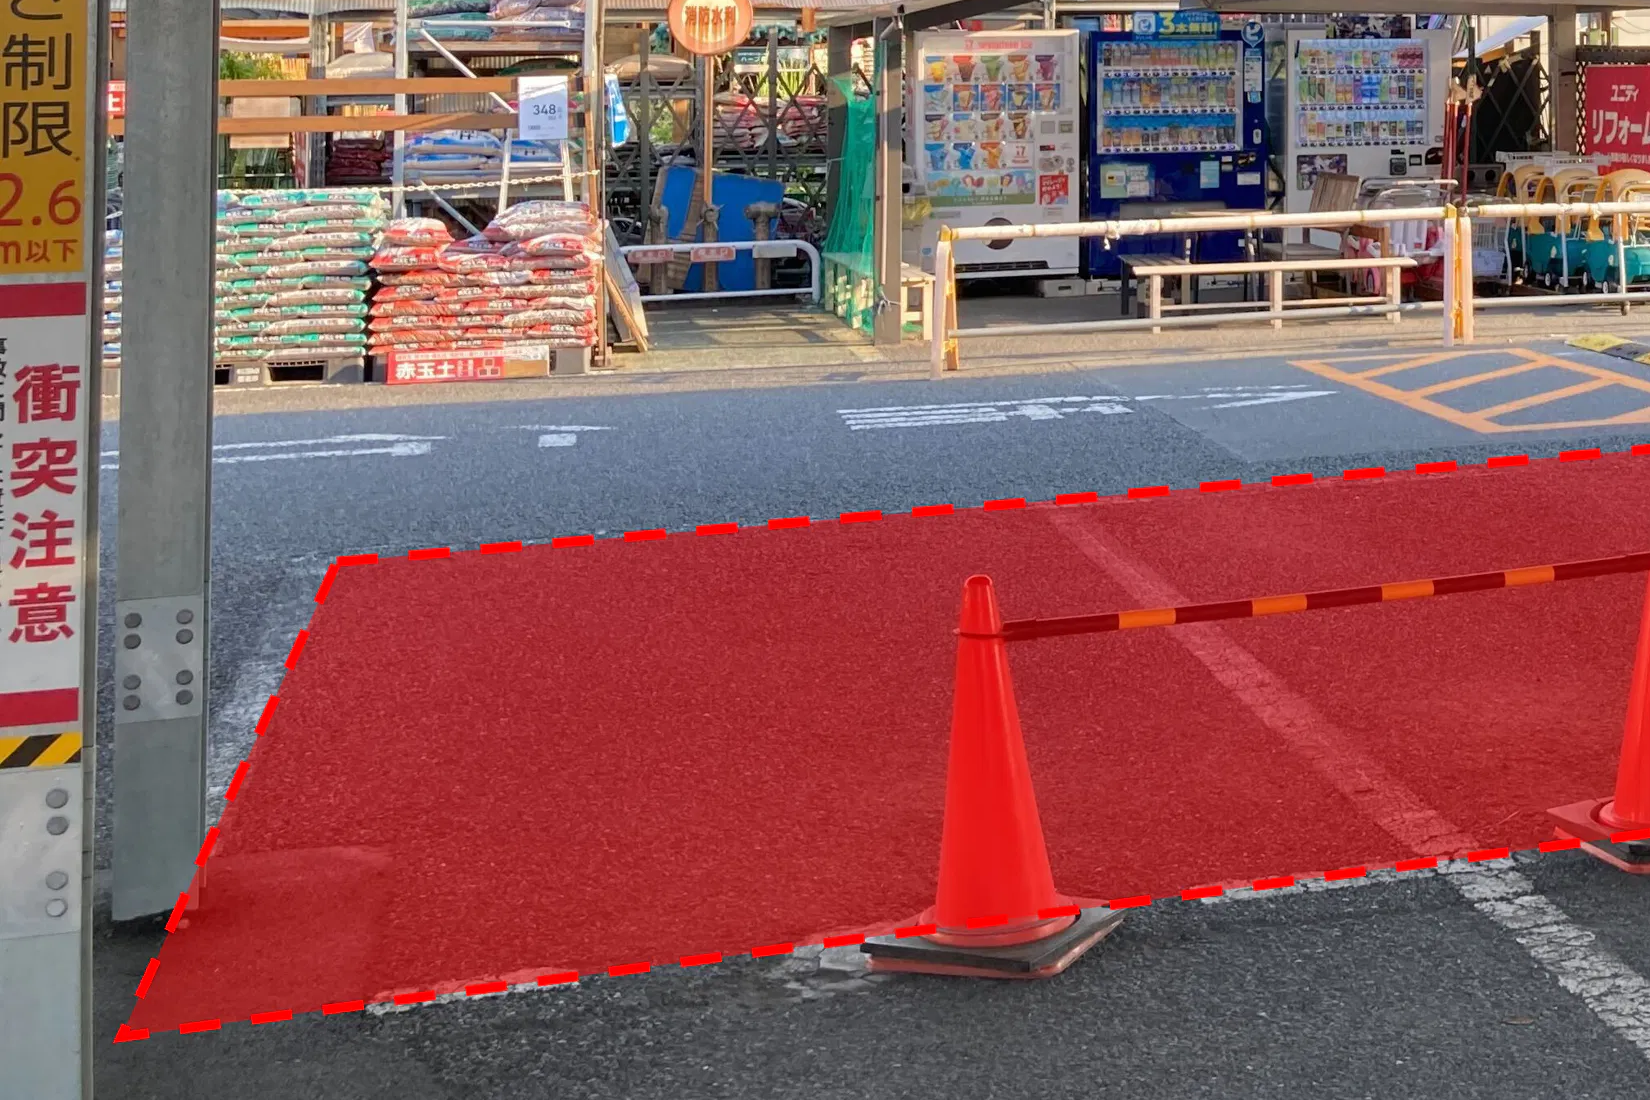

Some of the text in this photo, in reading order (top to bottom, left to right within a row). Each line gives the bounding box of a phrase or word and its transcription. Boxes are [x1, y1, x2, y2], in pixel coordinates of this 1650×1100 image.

[684, 5, 736, 26] 消防水利
[1610, 84, 1640, 102] ユニディ
[533, 103, 557, 115] 348
[0, 172, 82, 226] 2.6
[0, 239, 78, 268] m以下
[395, 360, 457, 380] 赤玉土
[8, 362, 81, 646] 衝突注意
